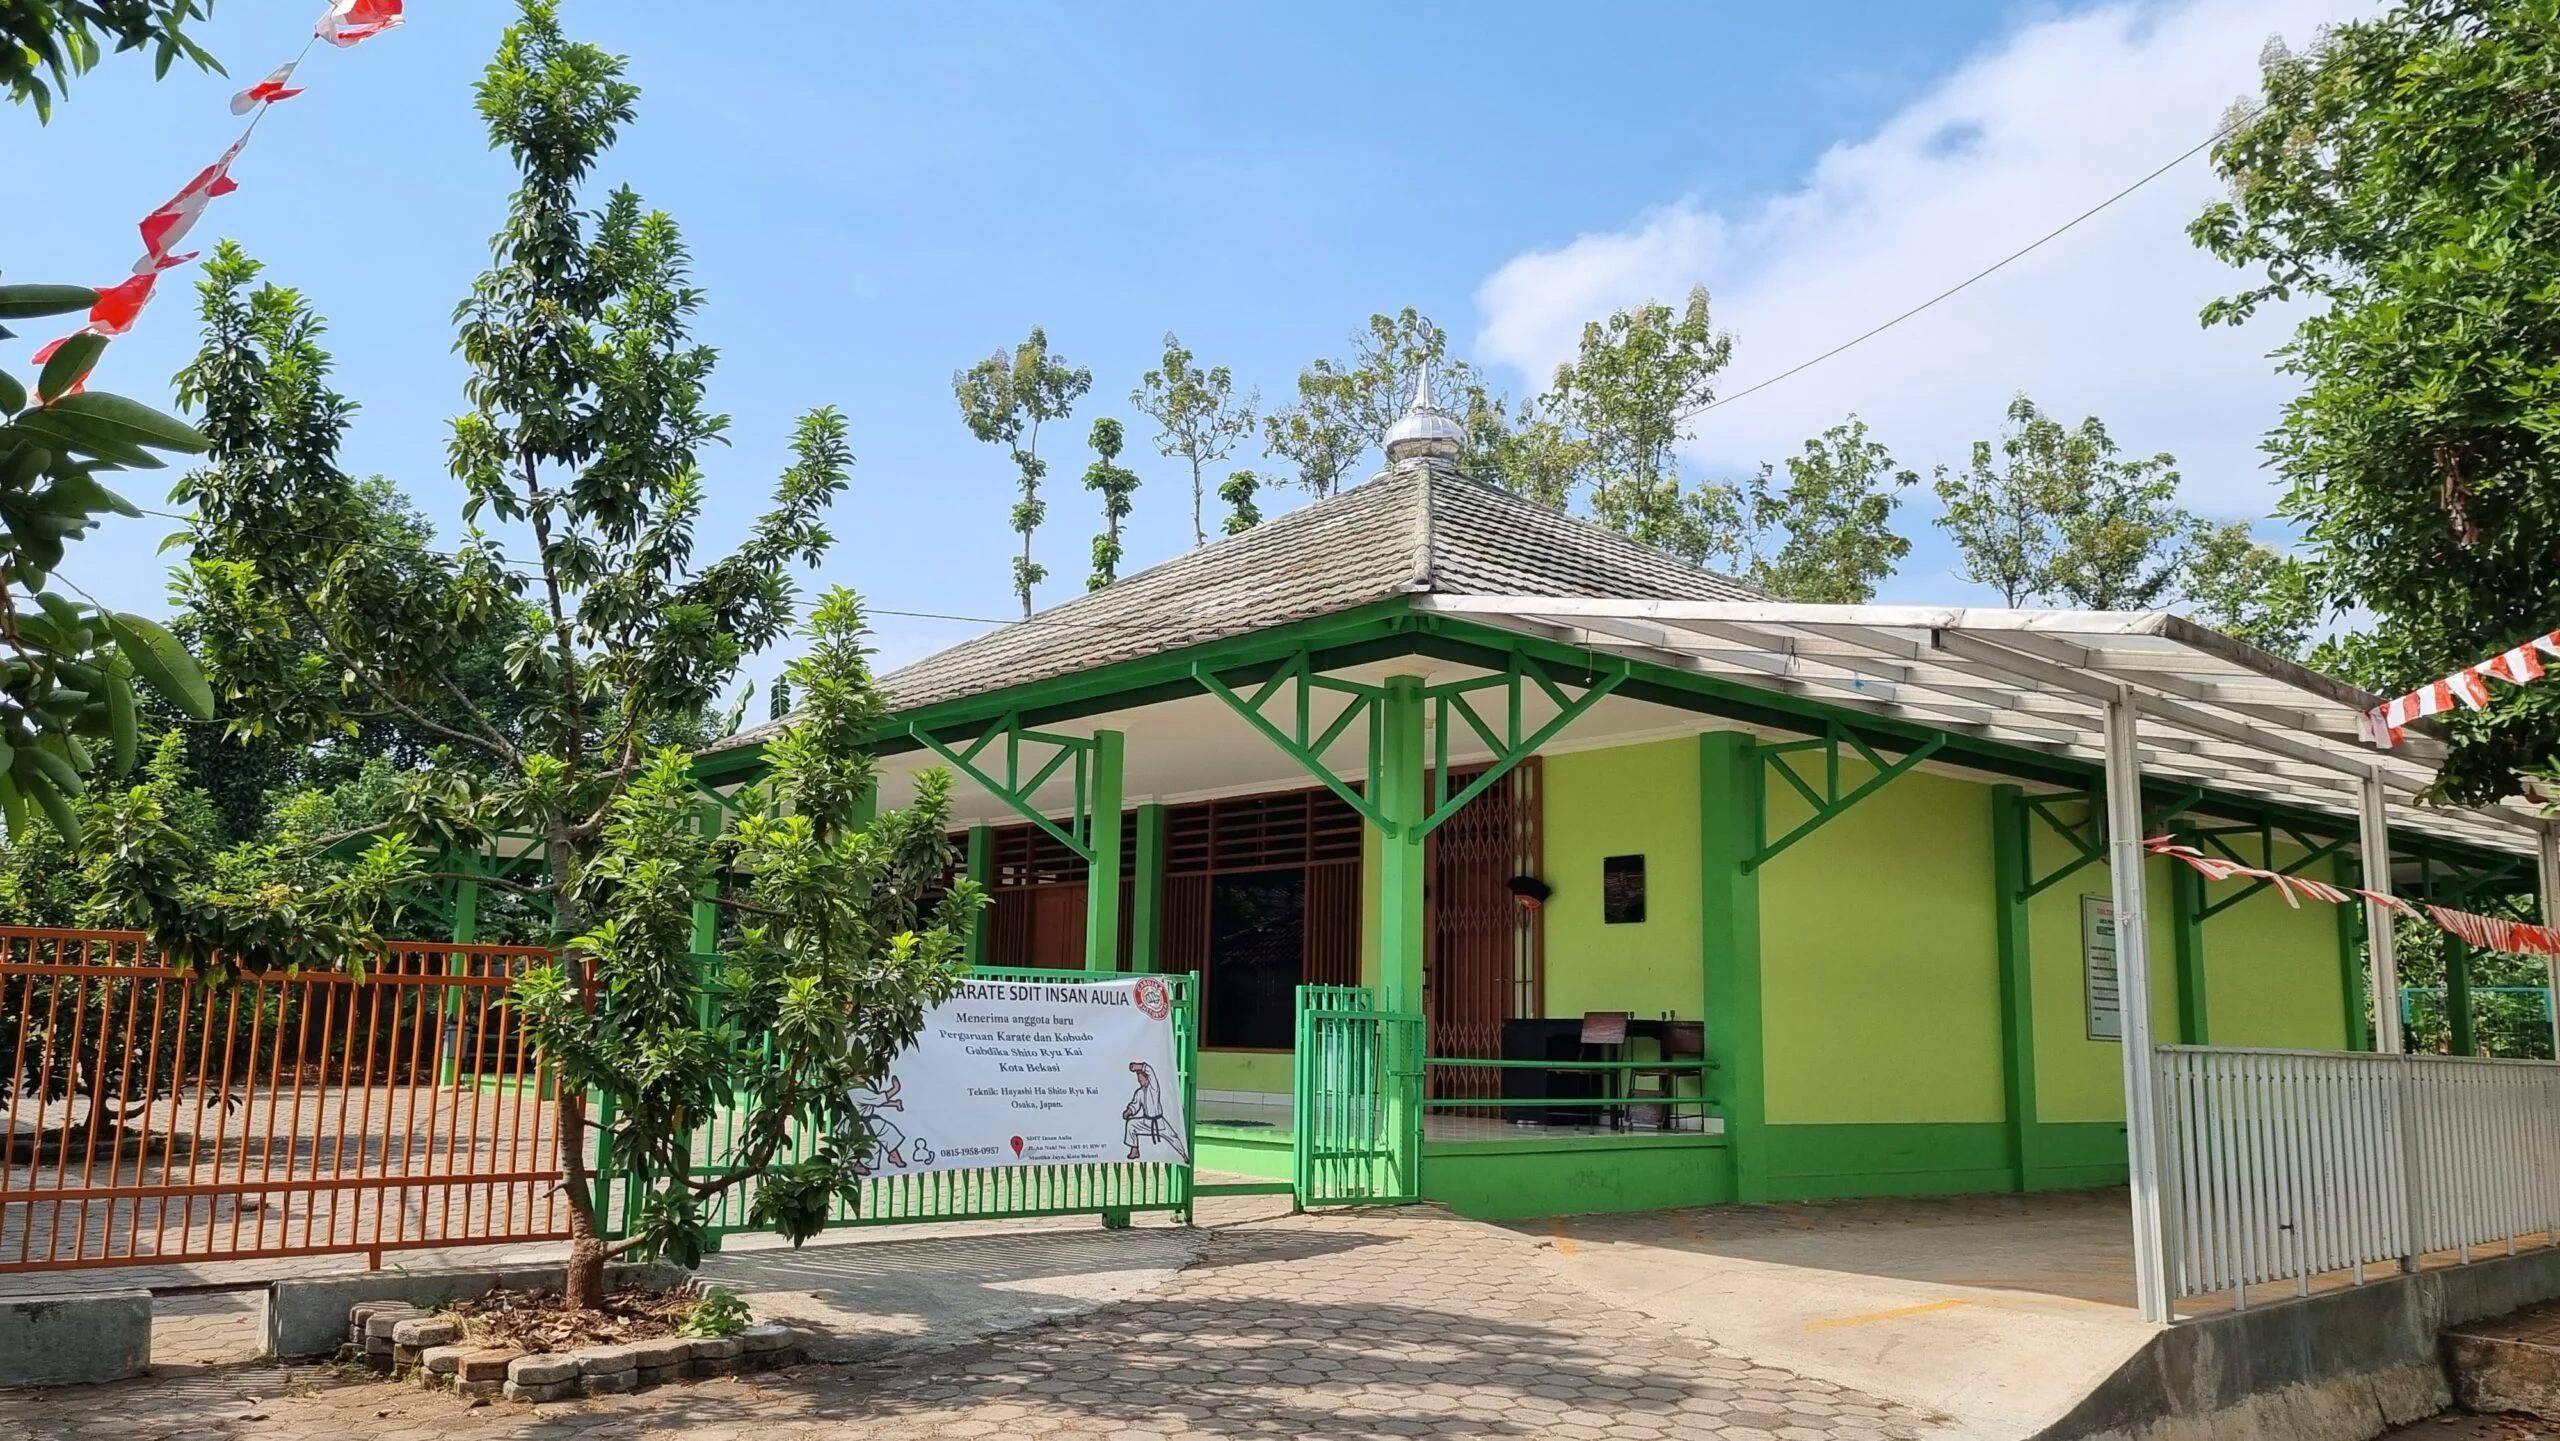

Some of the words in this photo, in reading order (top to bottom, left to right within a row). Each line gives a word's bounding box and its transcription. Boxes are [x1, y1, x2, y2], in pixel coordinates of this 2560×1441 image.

[1009, 985, 1042, 1001] SDIT
[1046, 987, 1088, 1003] INSAN
[1091, 989, 1130, 1006] AULIA
[956, 1012, 1009, 1023] Menerima
[1012, 1015, 1050, 1027] anggota
[1053, 1014, 1074, 1026] baru
[939, 1029, 993, 1042] Perguruan
[997, 1031, 1031, 1042] Karate
[1033, 1032, 1052, 1042] dan
[1054, 1032, 1094, 1042] Kobudo
[965, 1045, 1010, 1056] Gabdika
[1010, 1048, 1038, 1057] Shito
[1040, 1048, 1062, 1059] Ryu
[1064, 1047, 1083, 1056] Kai
[998, 1062, 1025, 1072] Kota
[1026, 1063, 1061, 1073] Bekasi
[967, 1087, 999, 1096] Teknik:
[1001, 1087, 1032, 1097] Hayashi
[1034, 1087, 1046, 1095] Ha
[1048, 1086, 1067, 1095] Shito
[1069, 1087, 1084, 1096] Ryu
[1086, 1086, 1099, 1095] Kai
[1011, 1100, 1038, 1109] Osaka,
[1040, 1100, 1064, 1110] Japan.
[940, 1146, 1000, 1157] 0815-1958-0957
